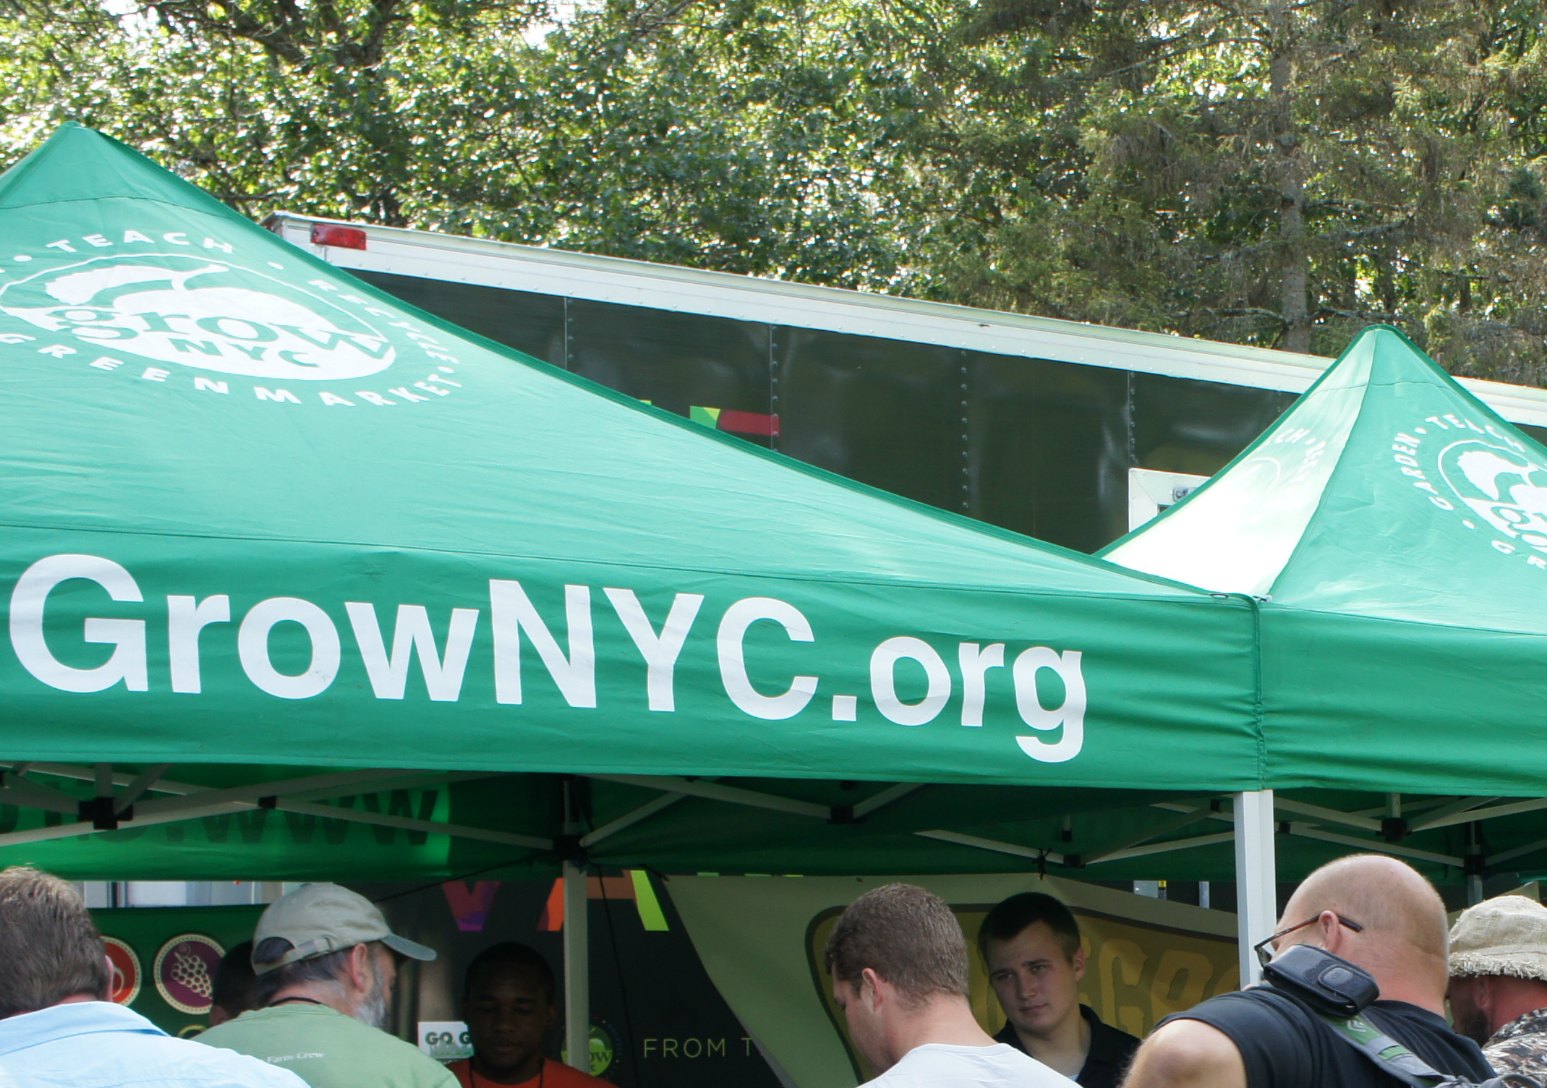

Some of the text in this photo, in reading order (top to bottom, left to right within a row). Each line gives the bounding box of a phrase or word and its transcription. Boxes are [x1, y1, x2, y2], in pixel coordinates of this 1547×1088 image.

[46, 229, 234, 255] TEACH
[169, 337, 321, 368] NYC
[9, 553, 1087, 763] GrowNYC.org
[643, 1037, 726, 1059] FROM
